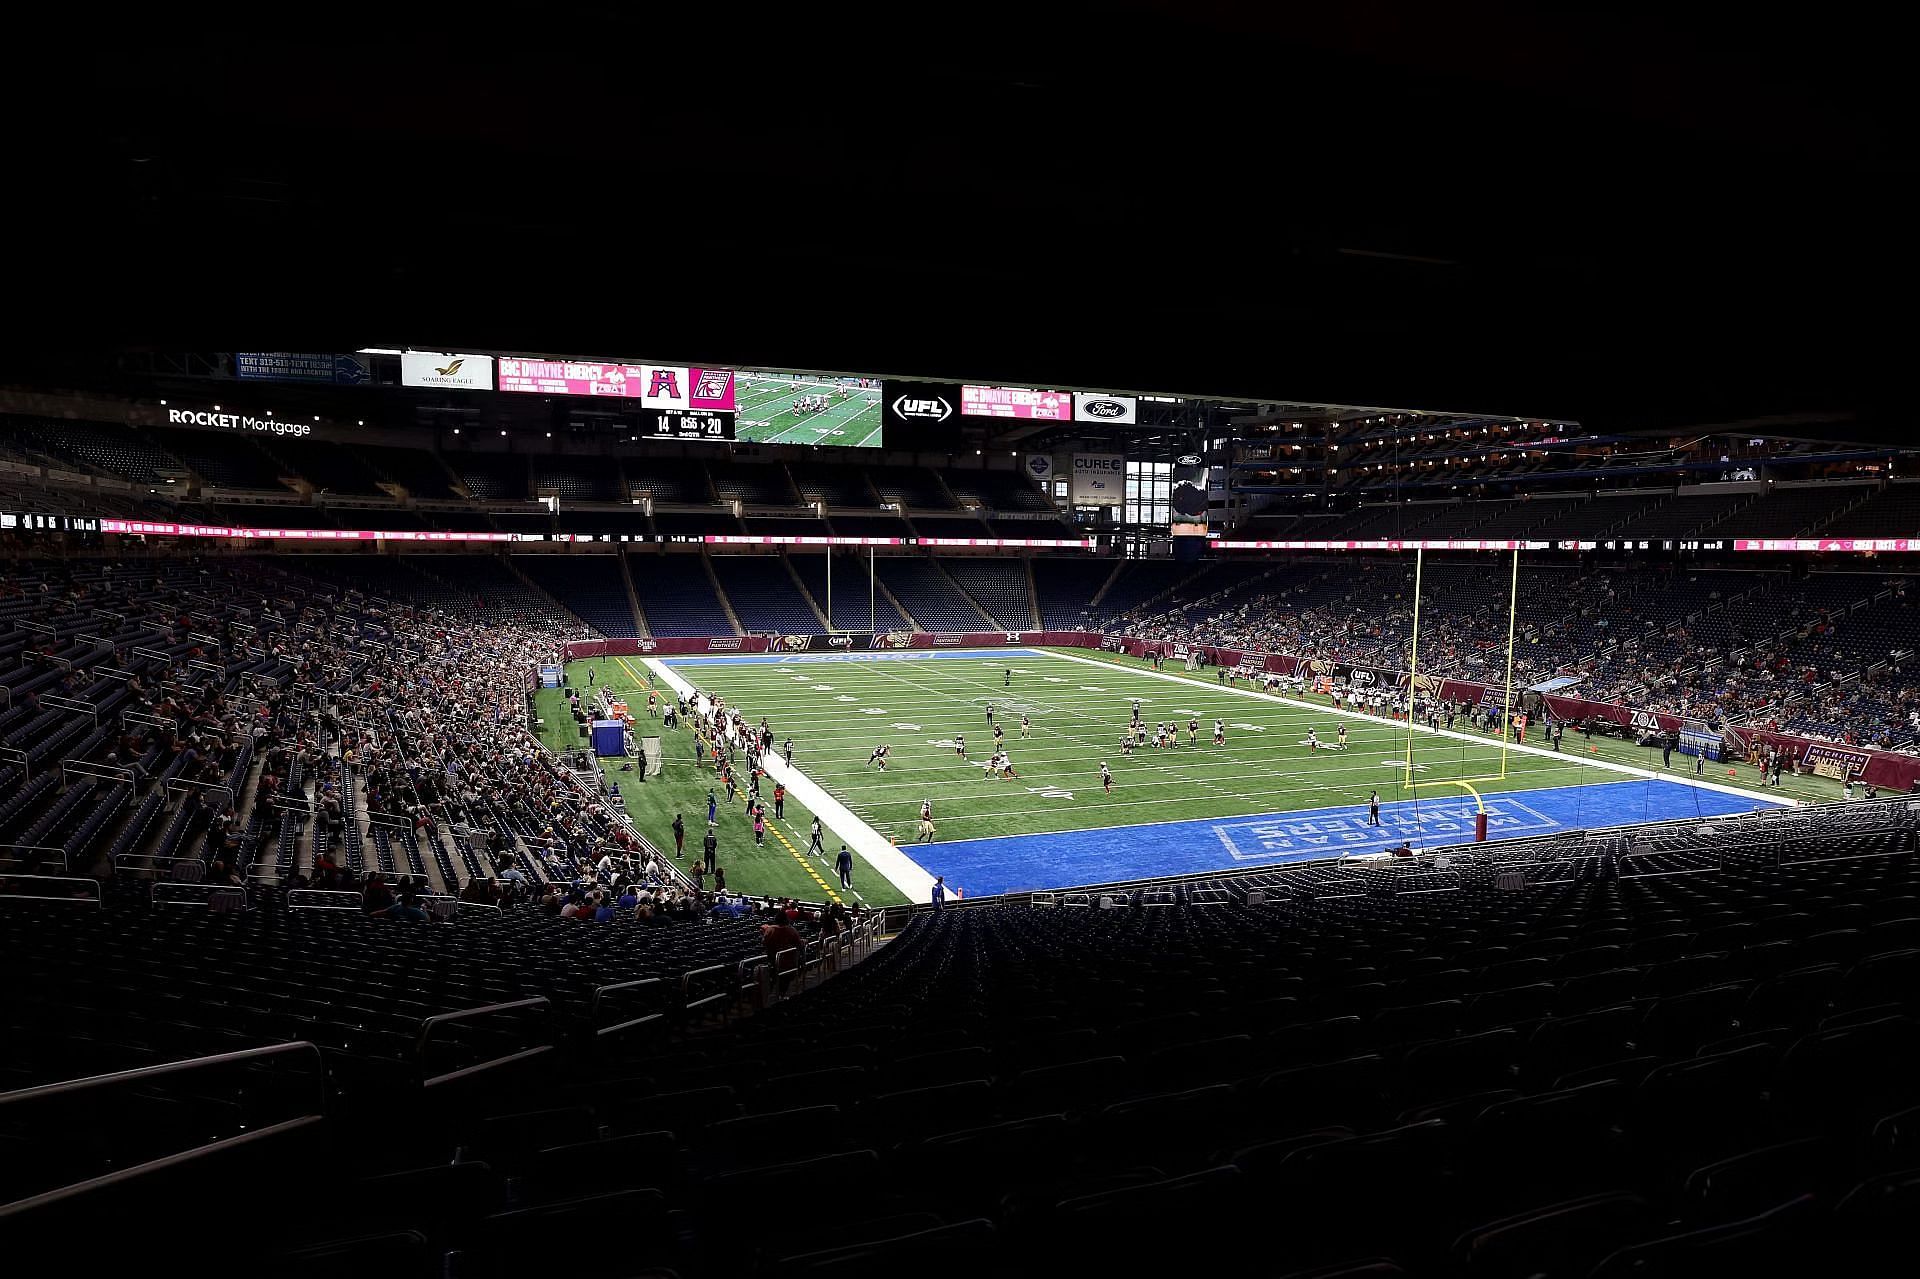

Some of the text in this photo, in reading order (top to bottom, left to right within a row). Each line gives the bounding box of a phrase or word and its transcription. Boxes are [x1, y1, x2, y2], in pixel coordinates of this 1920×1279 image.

[501, 360, 602, 381] BIG DWAYNE ENERGY
[421, 376, 451, 384] SOARING
[903, 399, 942, 414] UFL
[1092, 402, 1119, 416] Ford
[169, 409, 311, 437] ROCKET Mortgage
[657, 416, 669, 433] 14
[707, 418, 722, 435] 20
[1074, 458, 1109, 469] CURE
[1354, 670, 1372, 681] UFL
[1807, 754, 1862, 772] PANTHRS
[1811, 748, 1865, 763] MICHIGAN
